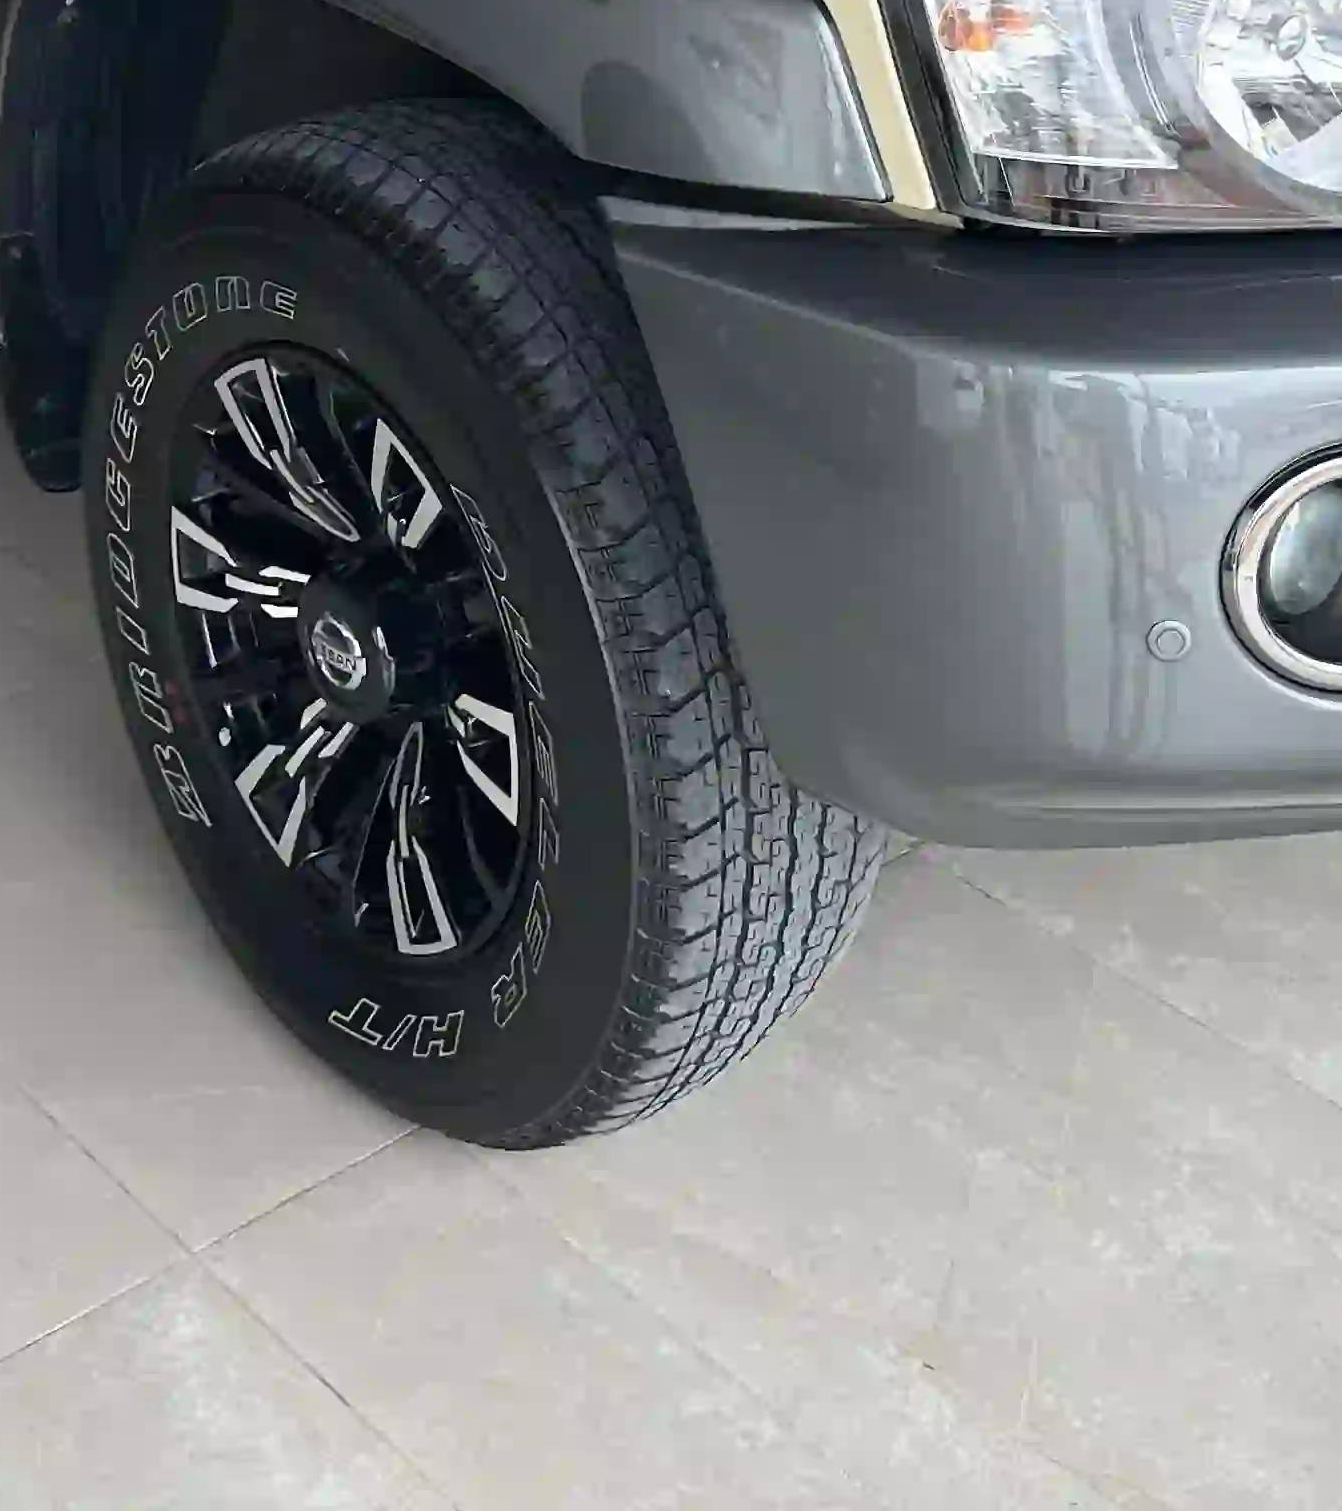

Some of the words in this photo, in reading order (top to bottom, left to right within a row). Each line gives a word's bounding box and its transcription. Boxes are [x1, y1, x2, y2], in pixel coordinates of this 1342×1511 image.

[105, 275, 300, 829] BRIDGESTONE
[449, 483, 561, 1029] DUELER
[327, 996, 465, 1059] H/T
